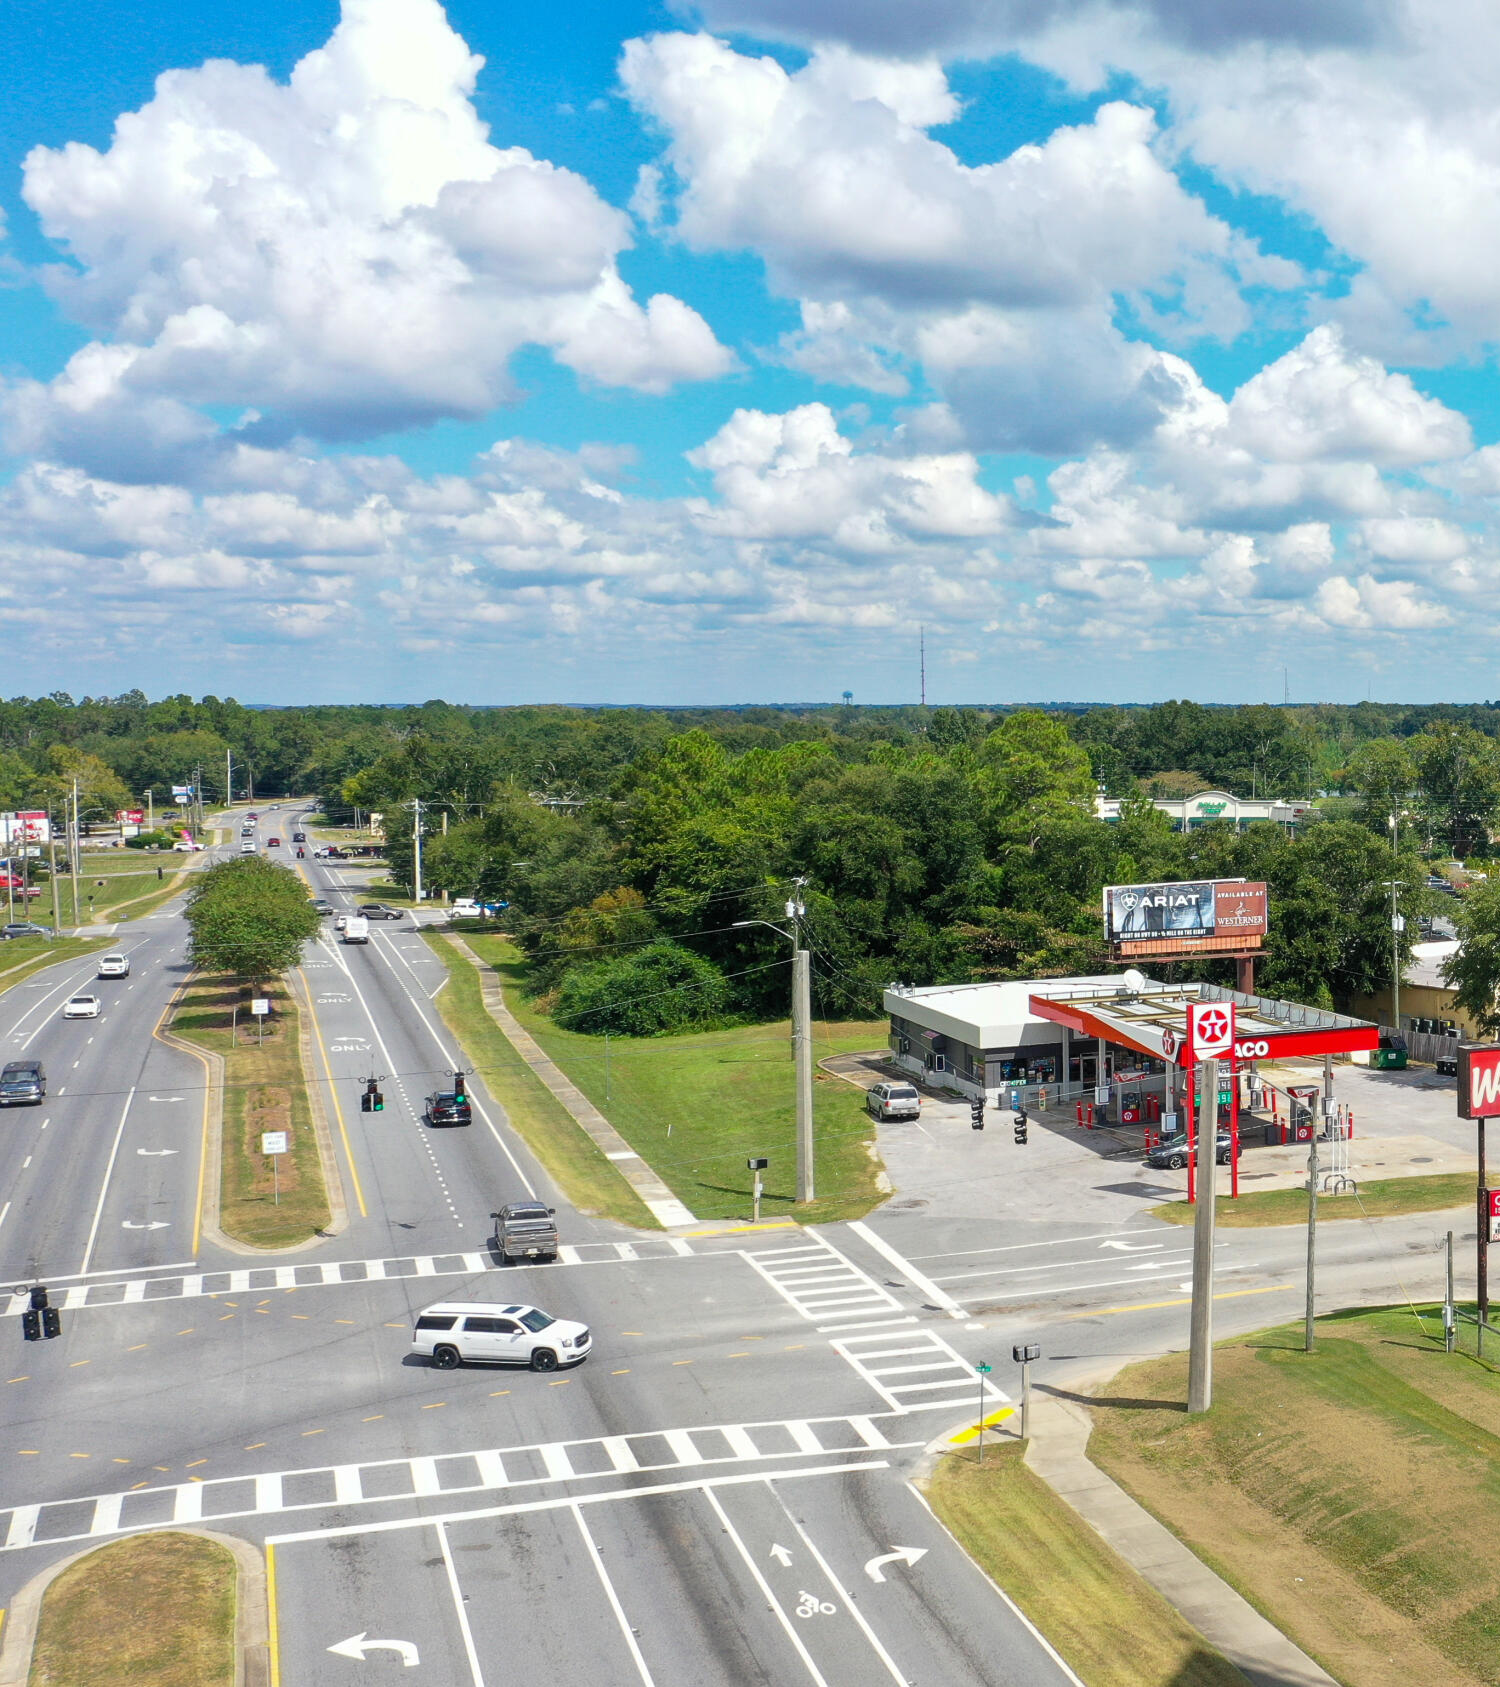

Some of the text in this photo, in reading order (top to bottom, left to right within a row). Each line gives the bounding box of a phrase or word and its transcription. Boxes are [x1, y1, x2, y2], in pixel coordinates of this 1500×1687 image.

[1139, 895, 1199, 908] ARIAT
[1217, 916, 1264, 925] WESTERNER
[330, 1044, 372, 1052] ONLY
[1235, 1041, 1269, 1058] ACO
